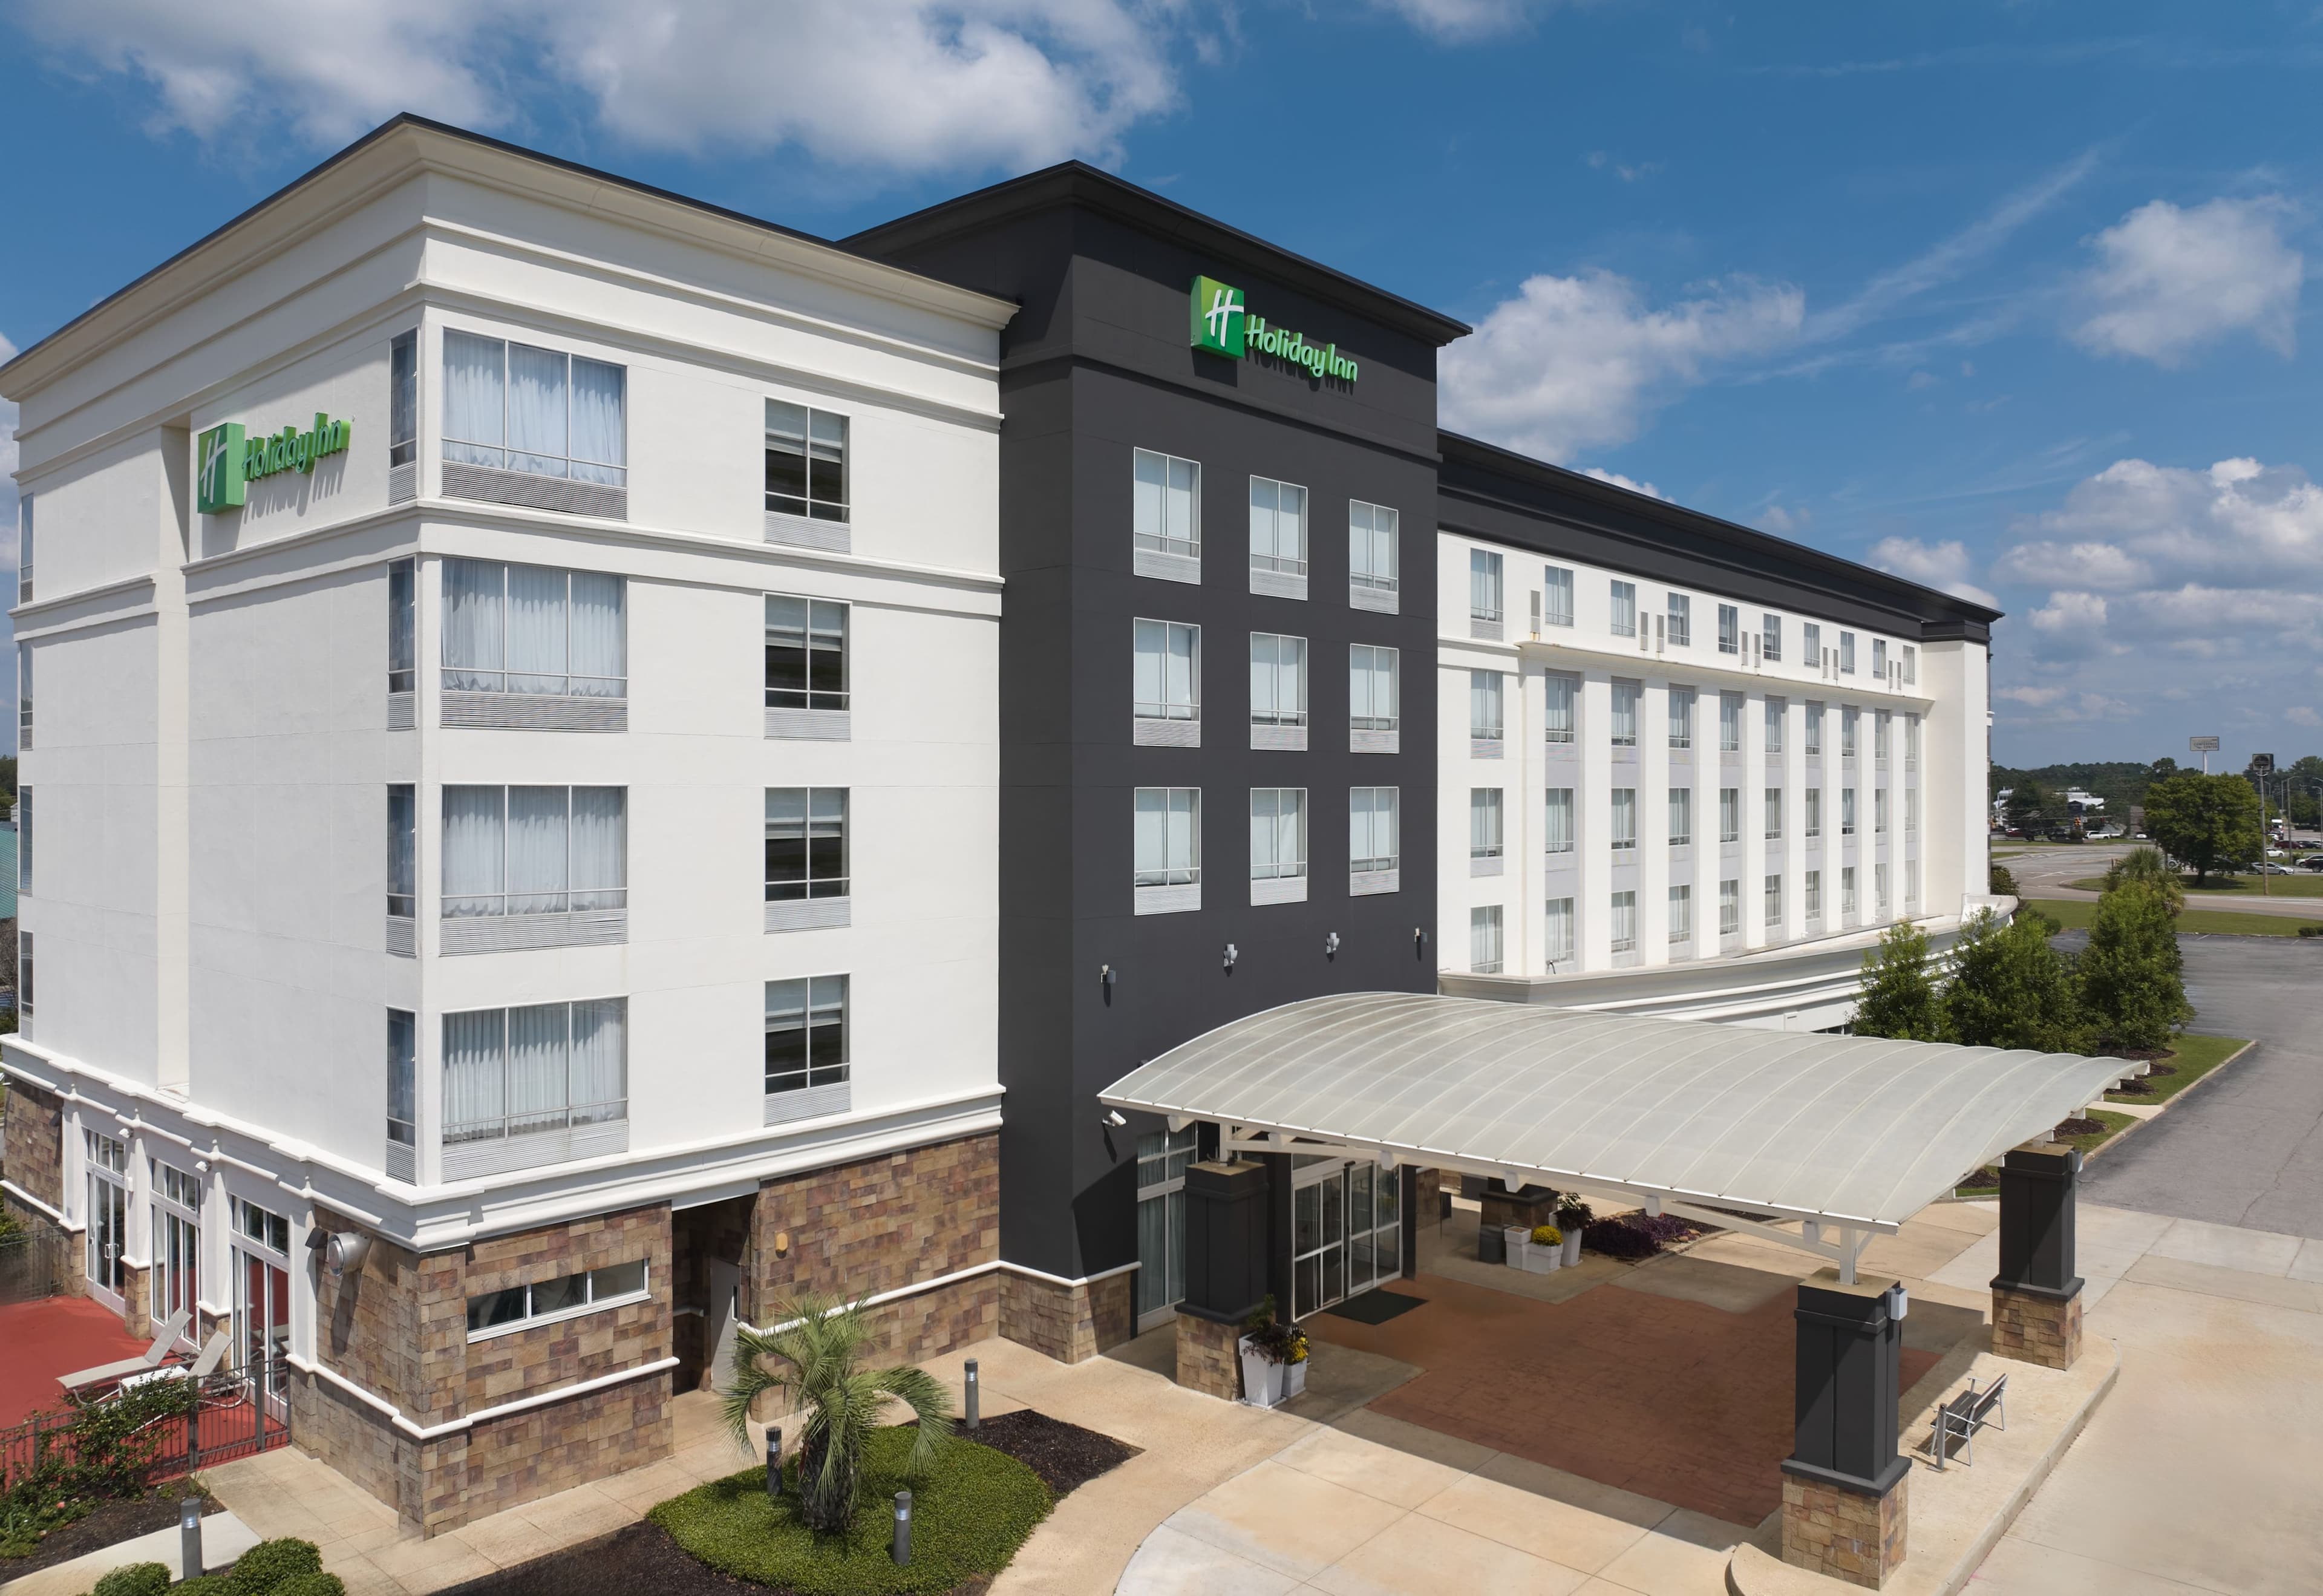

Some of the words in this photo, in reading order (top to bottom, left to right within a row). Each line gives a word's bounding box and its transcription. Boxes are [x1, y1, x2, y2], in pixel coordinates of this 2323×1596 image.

[1244, 314, 1327, 378] Holiday
[1327, 343, 1358, 382] Inn
[242, 426, 313, 480] Holiday
[312, 413, 349, 457] Inn
